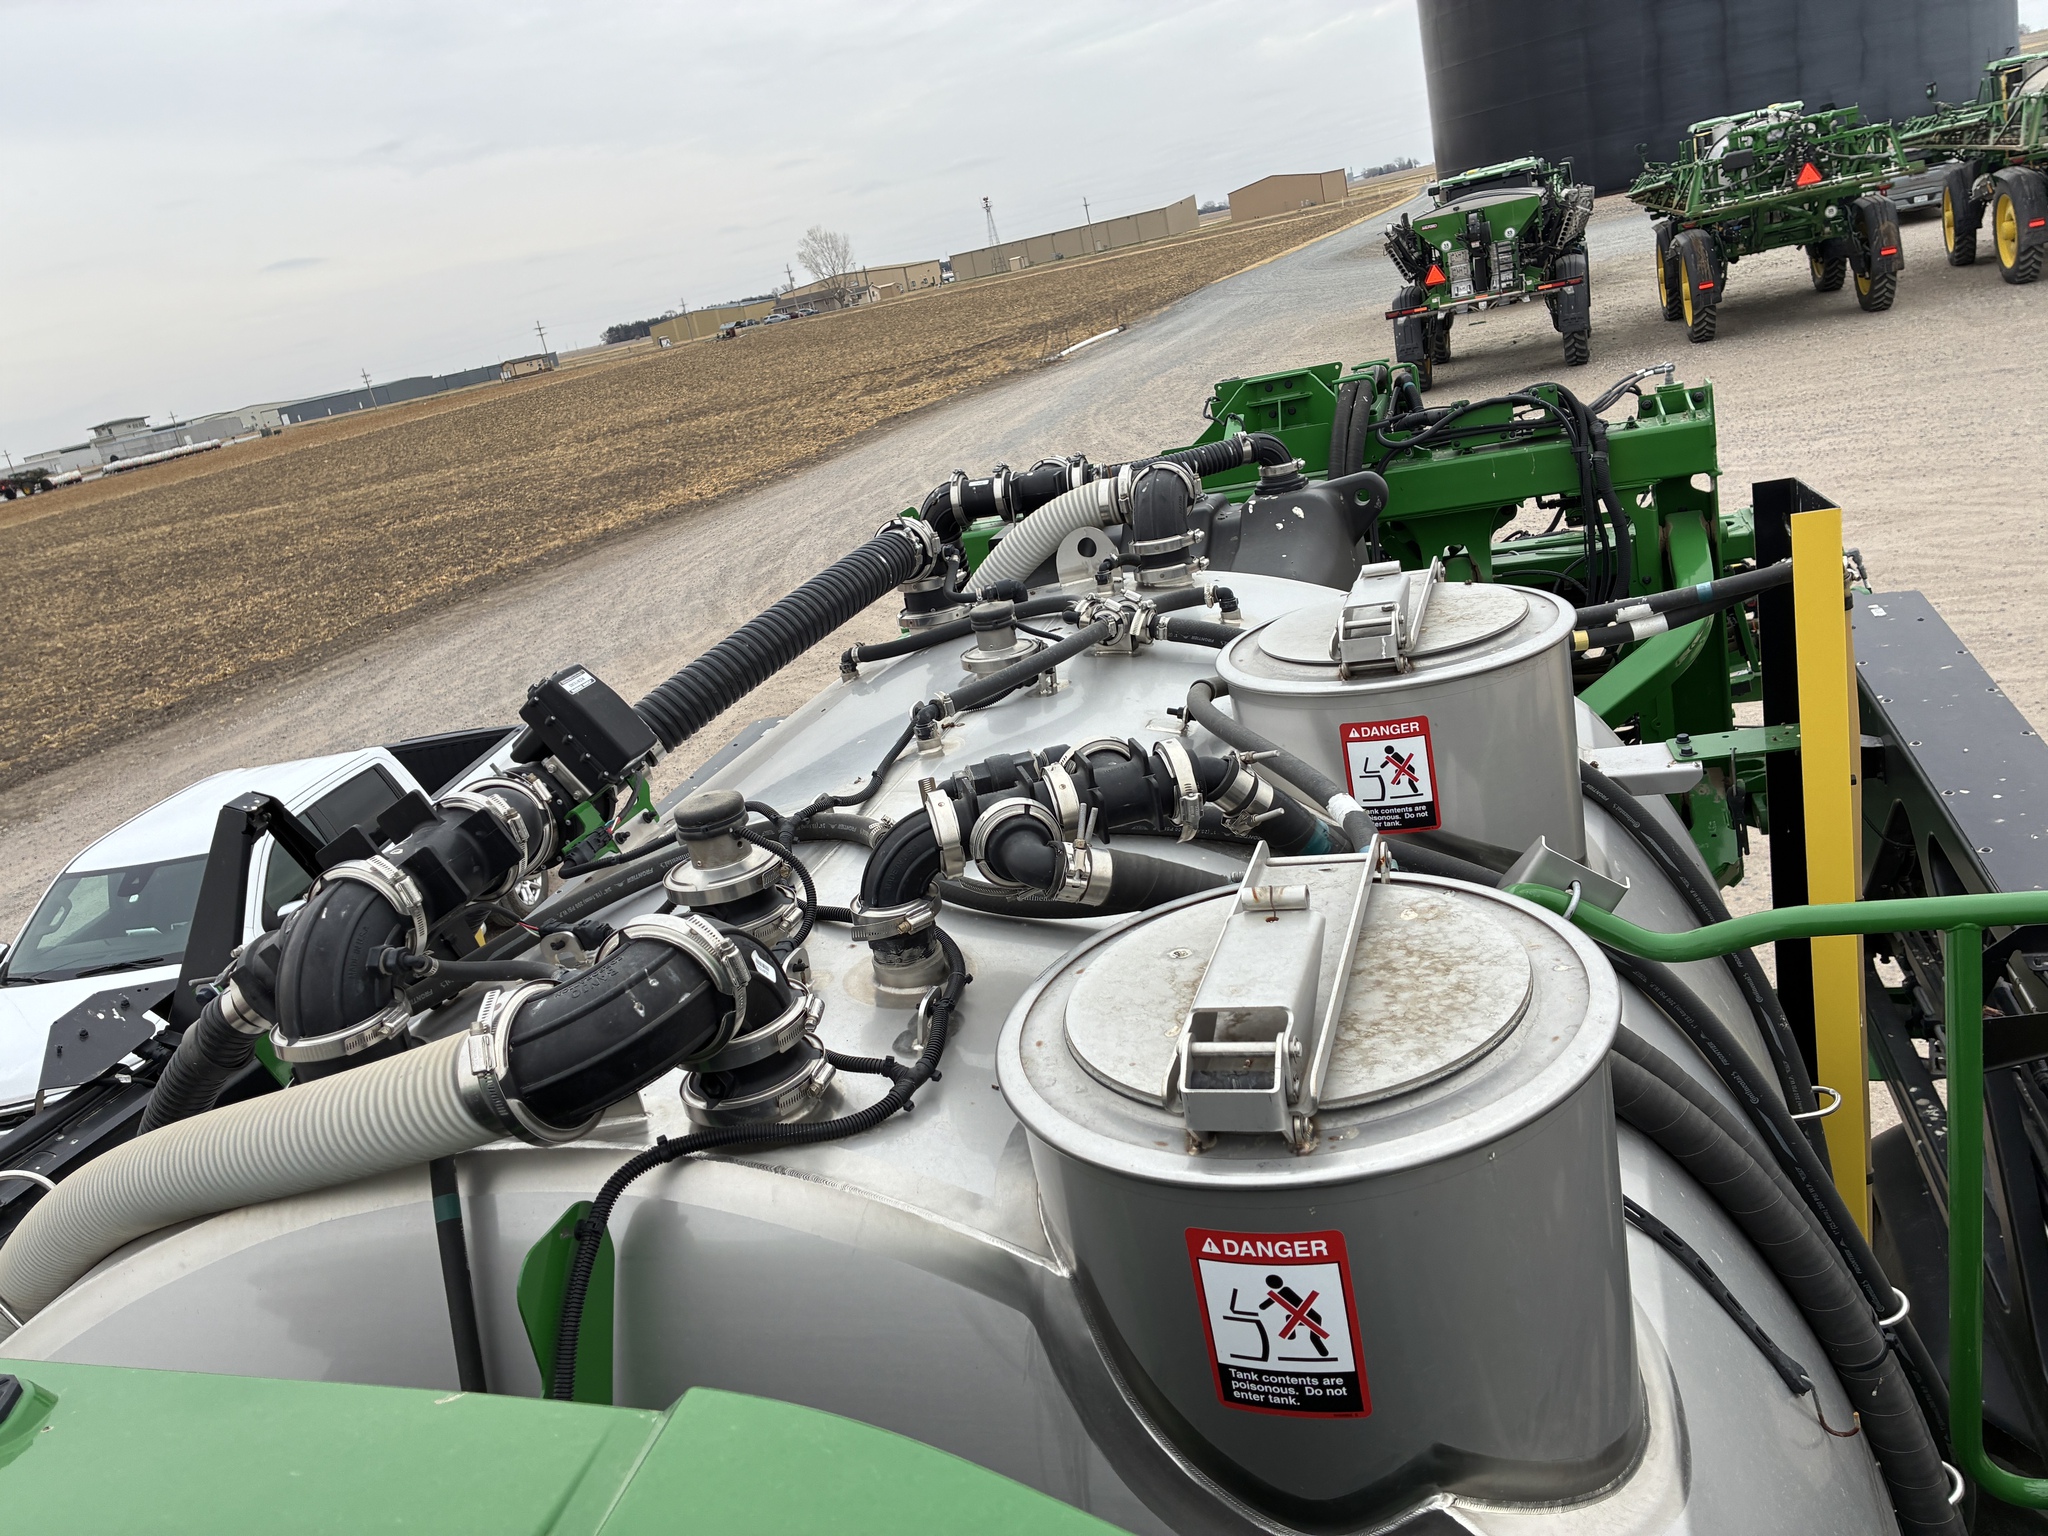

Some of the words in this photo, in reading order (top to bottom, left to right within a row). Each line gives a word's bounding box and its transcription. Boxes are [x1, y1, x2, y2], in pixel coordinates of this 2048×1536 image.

[1361, 722, 1420, 737] DANGER
[1586, 784, 1609, 800] FRONTIER
[664, 853, 690, 868] ontinental
[627, 868, 654, 884] FRONTIER
[1731, 952, 1743, 968] FRONT
[570, 969, 619, 999] BANJO
[411, 989, 433, 1005] FRONTI
[1658, 991, 1667, 999] PSI
[1707, 1041, 1730, 1066] FRONTIER
[1736, 1073, 1760, 1104] Continental
[1222, 1239, 1328, 1258] DANGER
[1844, 1249, 1862, 1274] FRONTIER
[1229, 1368, 1259, 1381] Tank
[1262, 1374, 1318, 1386] contents
[1322, 1377, 1344, 1386] are
[1232, 1380, 1299, 1395] poisonous.
[1305, 1386, 1323, 1396] Do
[1326, 1387, 1347, 1396] not
[1233, 1391, 1264, 1402] enter
[1268, 1394, 1300, 1405] tank.
